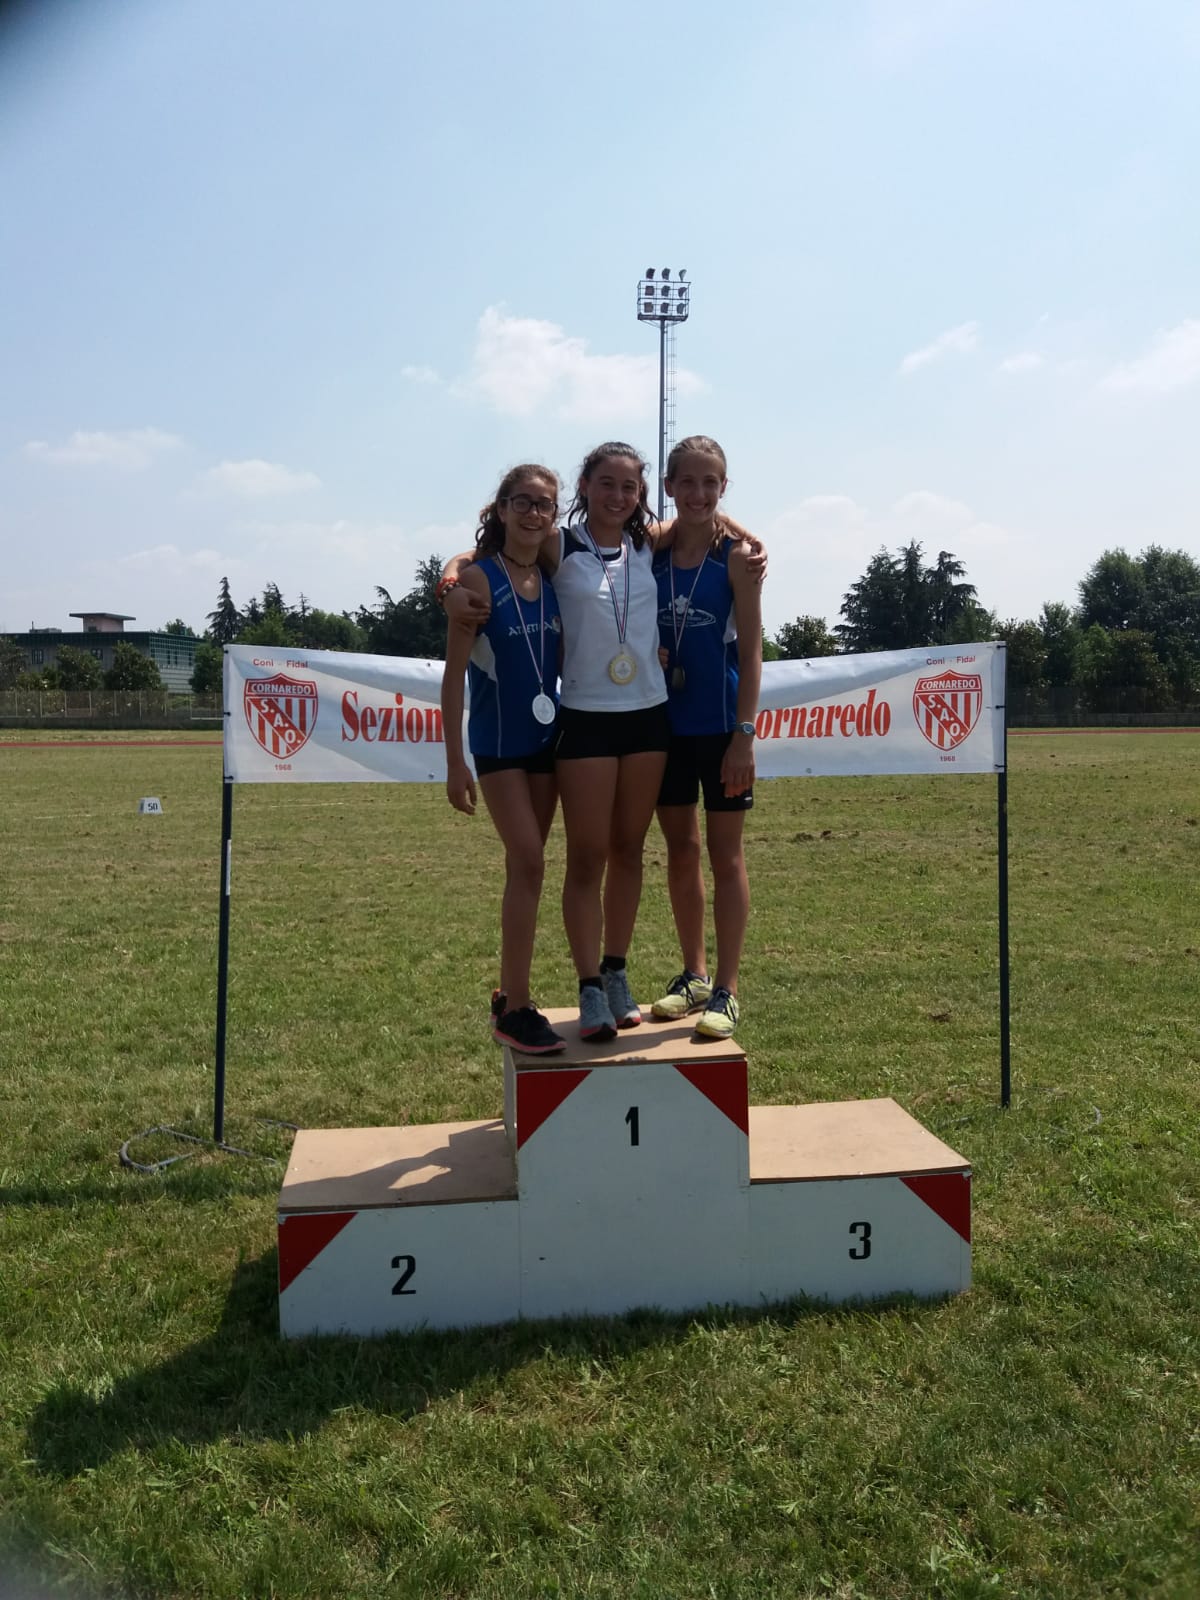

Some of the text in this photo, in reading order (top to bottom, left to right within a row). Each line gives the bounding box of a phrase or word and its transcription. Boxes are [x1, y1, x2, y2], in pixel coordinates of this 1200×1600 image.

[253, 658, 308, 669] Coni Fidal
[926, 655, 976, 666] Coni Fidal
[250, 682, 312, 695] CORNAREDO
[921, 679, 976, 690] CORNAREDO
[341, 690, 444, 743] Sezion
[755, 689, 891, 740] ornaredo
[147, 802, 159, 811] 50
[624, 1105, 640, 1147] 1
[848, 1221, 873, 1261] 3
[390, 1254, 417, 1296] 2
